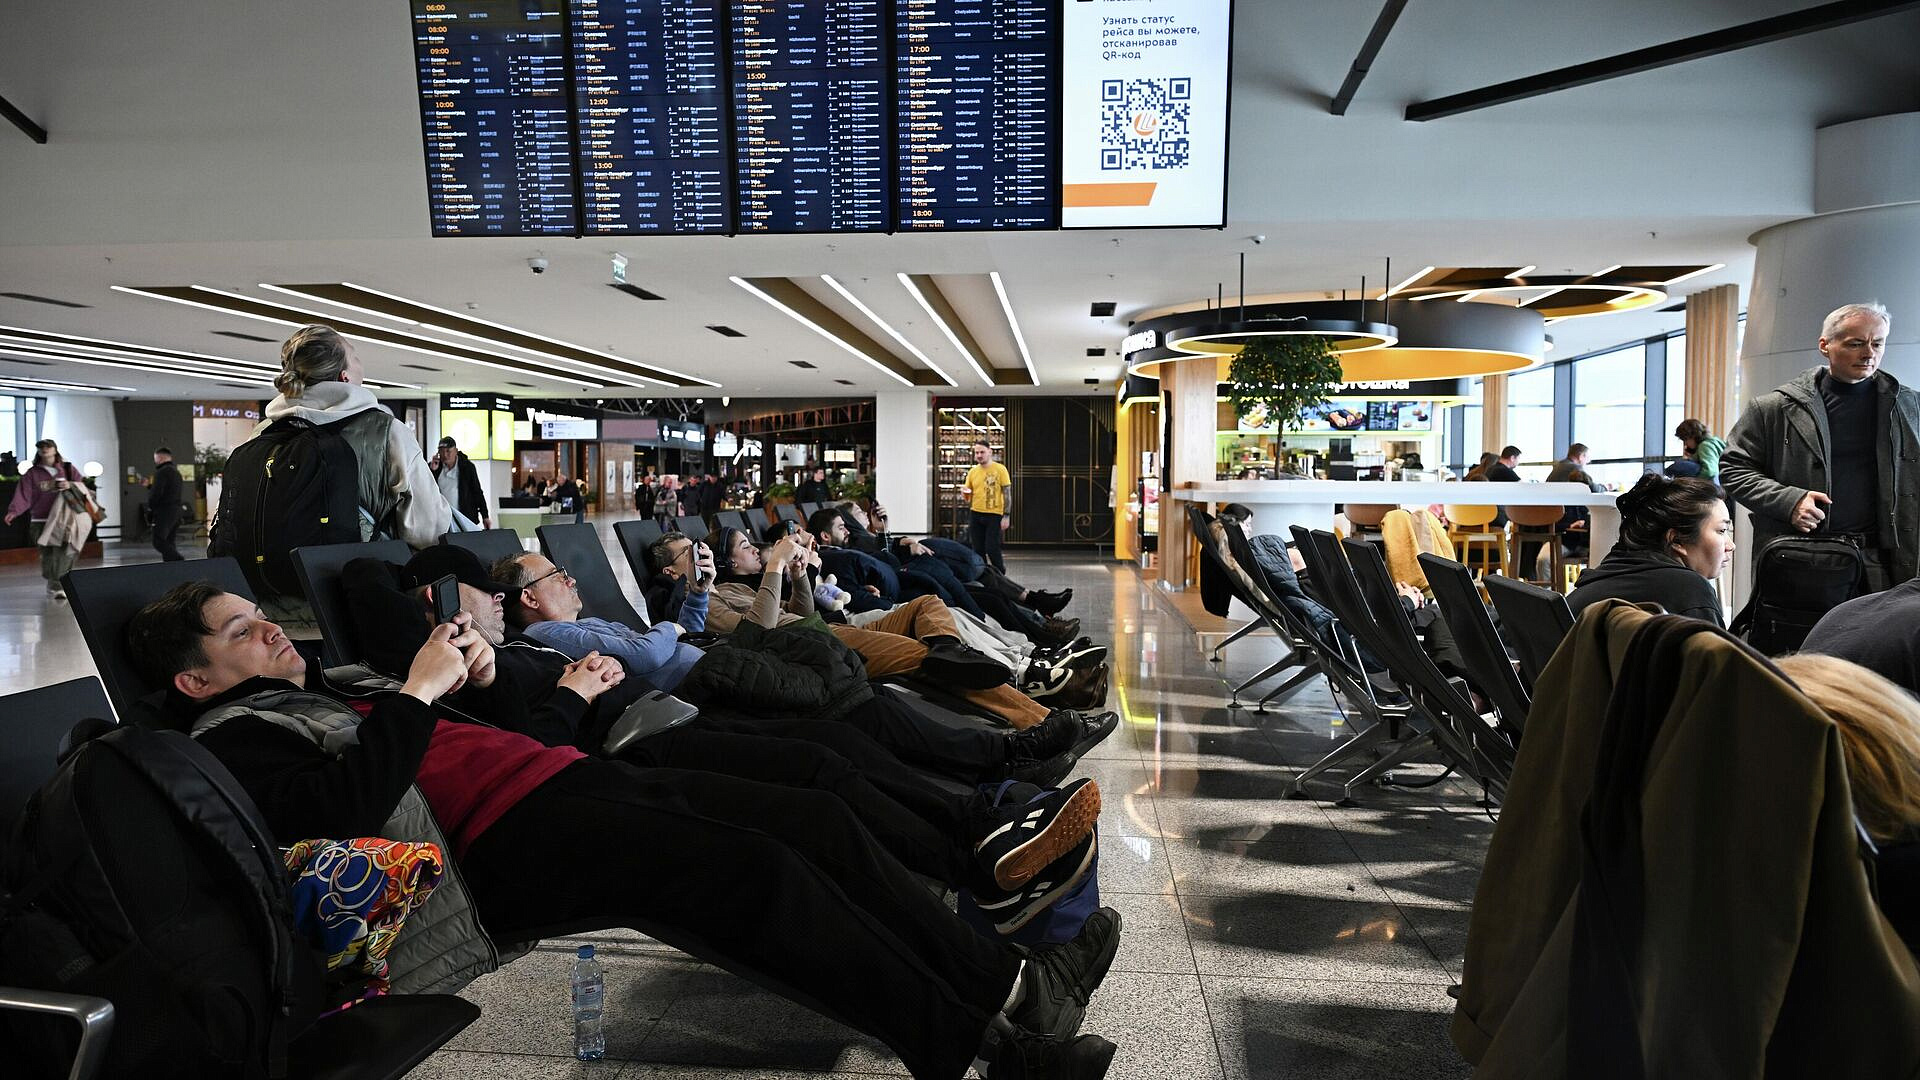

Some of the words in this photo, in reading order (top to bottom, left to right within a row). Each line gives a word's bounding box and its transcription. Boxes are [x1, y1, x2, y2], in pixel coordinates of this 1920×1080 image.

[1103, 17, 1138, 25] Узнать
[1142, 16, 1175, 25] статус
[1103, 28, 1134, 38] рейса
[1155, 26, 1200, 36] можете,
[1103, 39, 1178, 49] отсканировав
[1103, 51, 1142, 61] QR-код
[747, 72, 766, 80] 15:00
